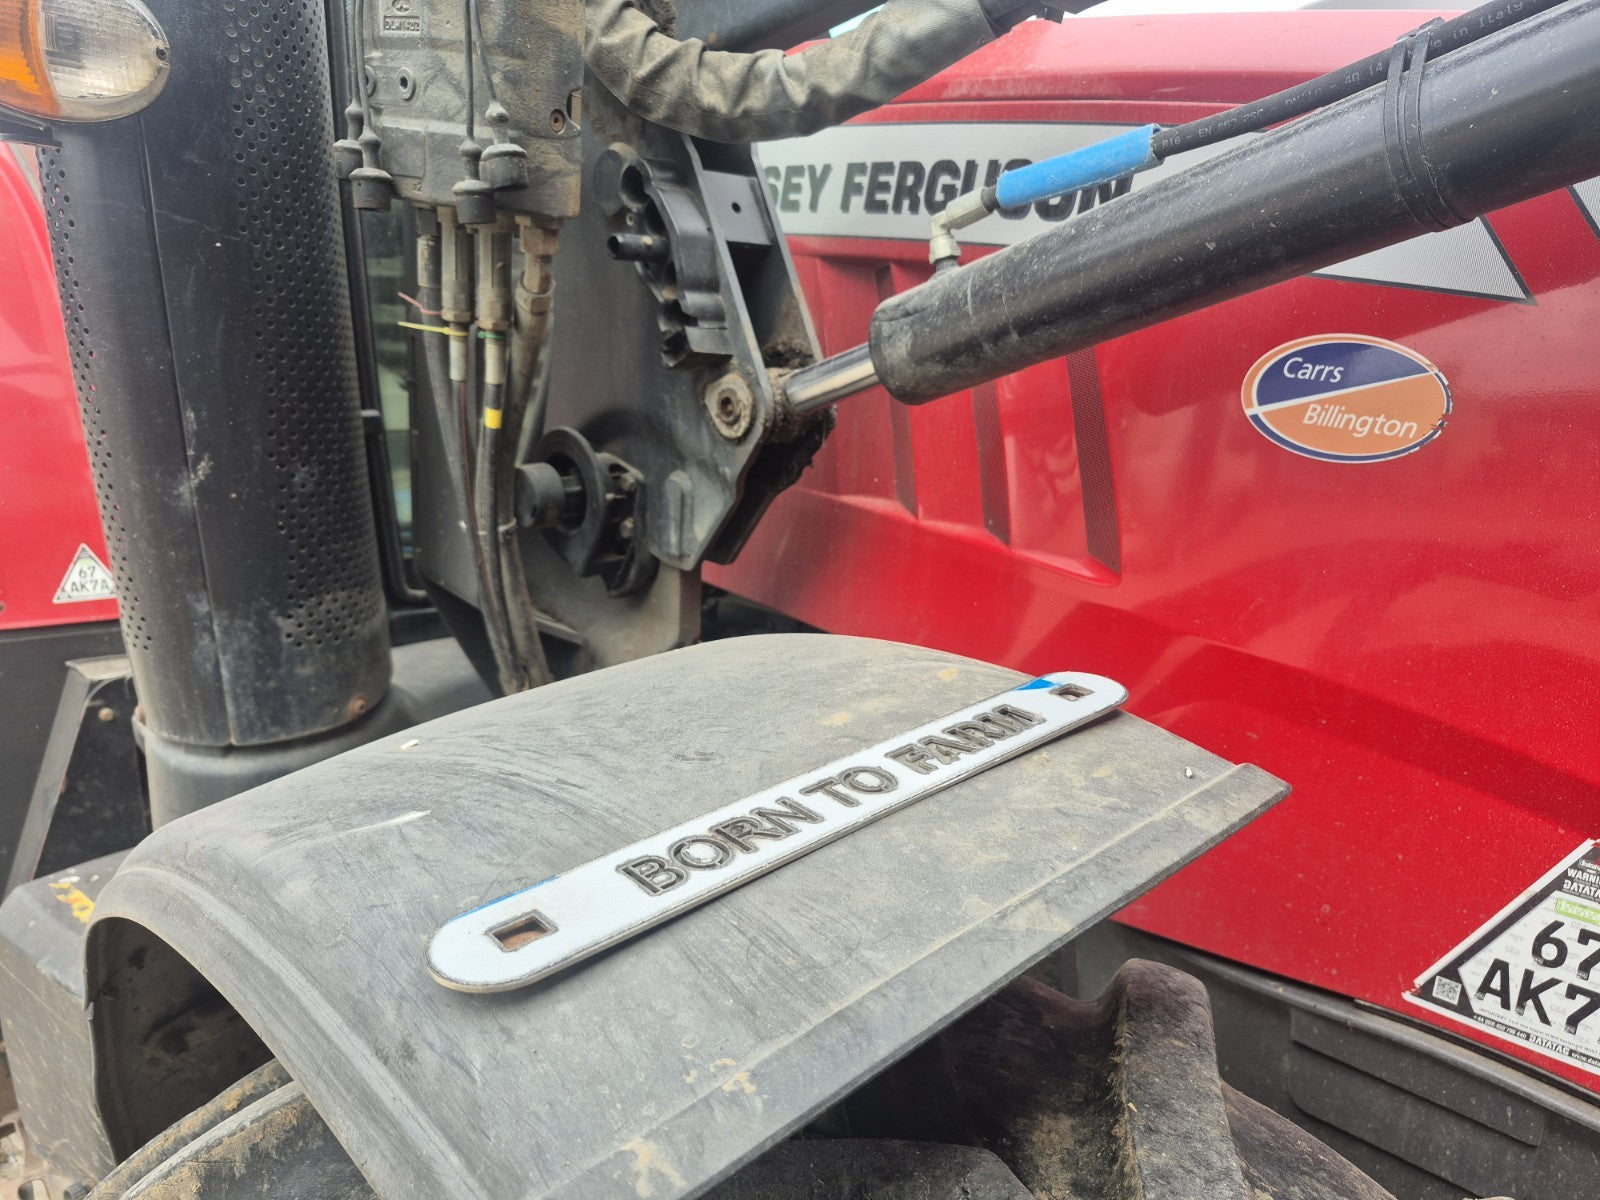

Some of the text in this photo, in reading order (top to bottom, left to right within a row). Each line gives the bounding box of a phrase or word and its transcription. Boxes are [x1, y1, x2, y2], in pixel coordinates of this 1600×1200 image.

[1452, 27, 1469, 39] in
[1479, 1, 1524, 28] Italy
[1198, 126, 1212, 138] EN
[1283, 357, 1344, 383] Carrs
[1302, 403, 1418, 439] Billington
[79, 566, 96, 579] 67
[615, 703, 1047, 897] BORN TO FARM
[1567, 867, 1600, 886] WARNI
[1531, 919, 1600, 981] 67
[1474, 957, 1600, 1036] AK7
[1529, 1034, 1571, 1056] DATATAG
